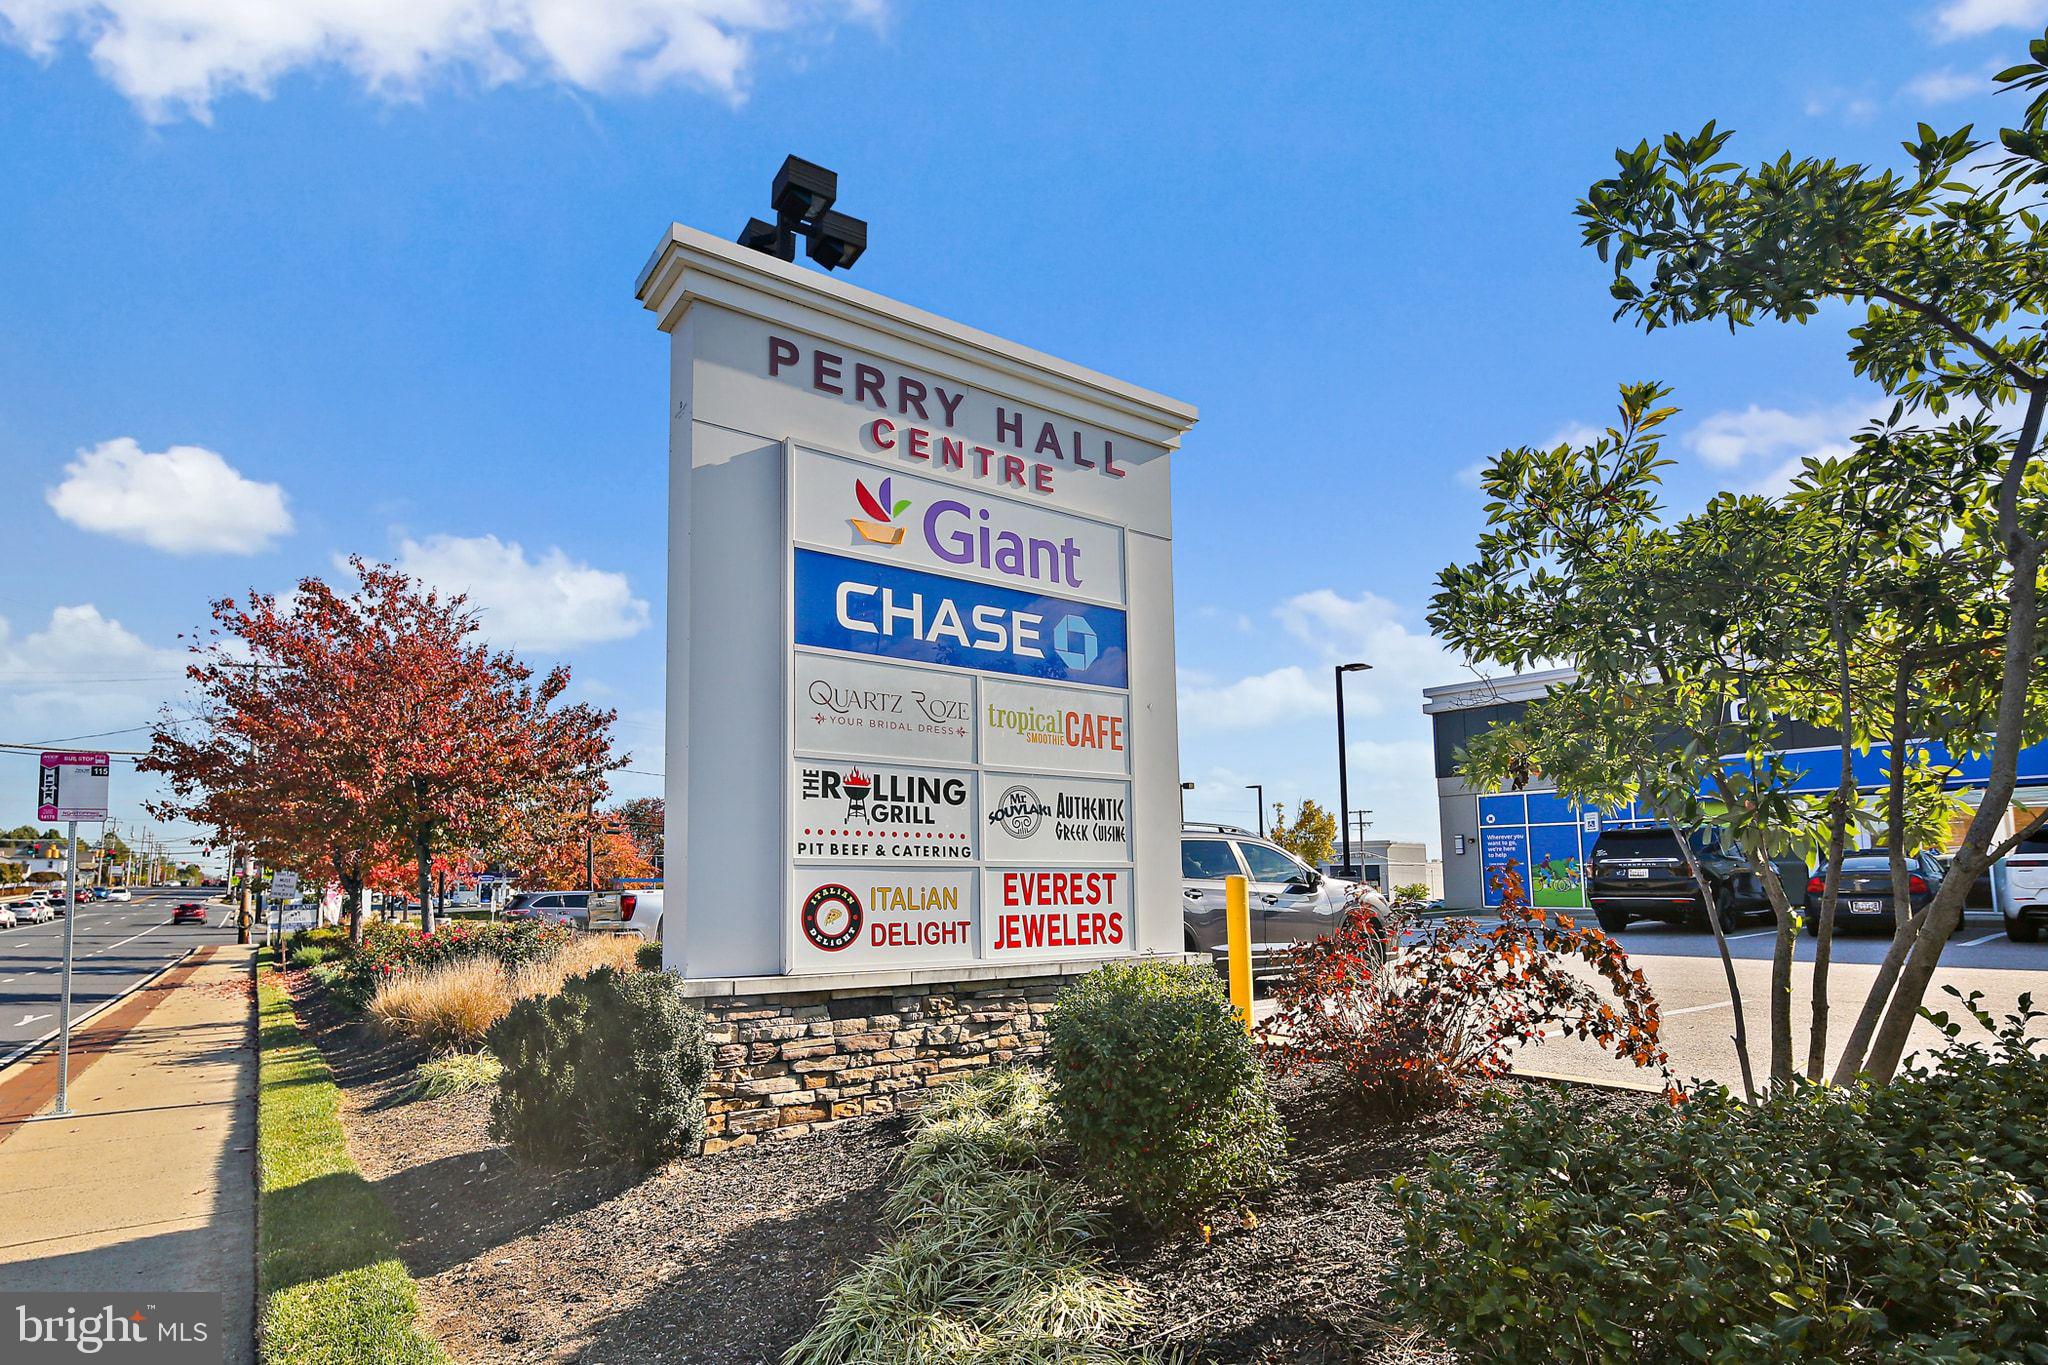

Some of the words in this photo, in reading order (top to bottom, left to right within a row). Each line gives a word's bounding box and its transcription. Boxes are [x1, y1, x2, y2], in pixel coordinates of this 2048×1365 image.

[769, 335, 965, 427] PERRY
[997, 406, 1126, 478] HALL
[871, 418, 1055, 493] CENTRE
[923, 499, 1083, 588] Giant
[836, 581, 1045, 659] CHASE
[808, 680, 903, 714] QUARTZ
[911, 690, 970, 724] ROZE
[829, 715, 864, 727] YOUR
[869, 719, 913, 732] BRIDAL
[918, 724, 955, 735] DRESS
[988, 703, 1064, 735] tropical
[1065, 711, 1123, 751] CAFE
[1026, 732, 1065, 746] SMOOTHIE
[94, 767, 109, 775] 115
[802, 768, 820, 800] THE
[870, 804, 936, 825] GRILL
[988, 804, 1052, 825] SOUVLAKI
[1056, 792, 1124, 822] AUTHENTIC
[1055, 821, 1089, 841] GREEK
[1092, 822, 1126, 843] CUISINE
[797, 842, 824, 855] PIT
[830, 843, 869, 856] BEEF
[875, 844, 886, 857] &
[892, 844, 972, 858] CATERING
[1003, 872, 1118, 907] EVEREST
[870, 921, 971, 947] DELIGHT
[993, 912, 1124, 950] JEWELERS
